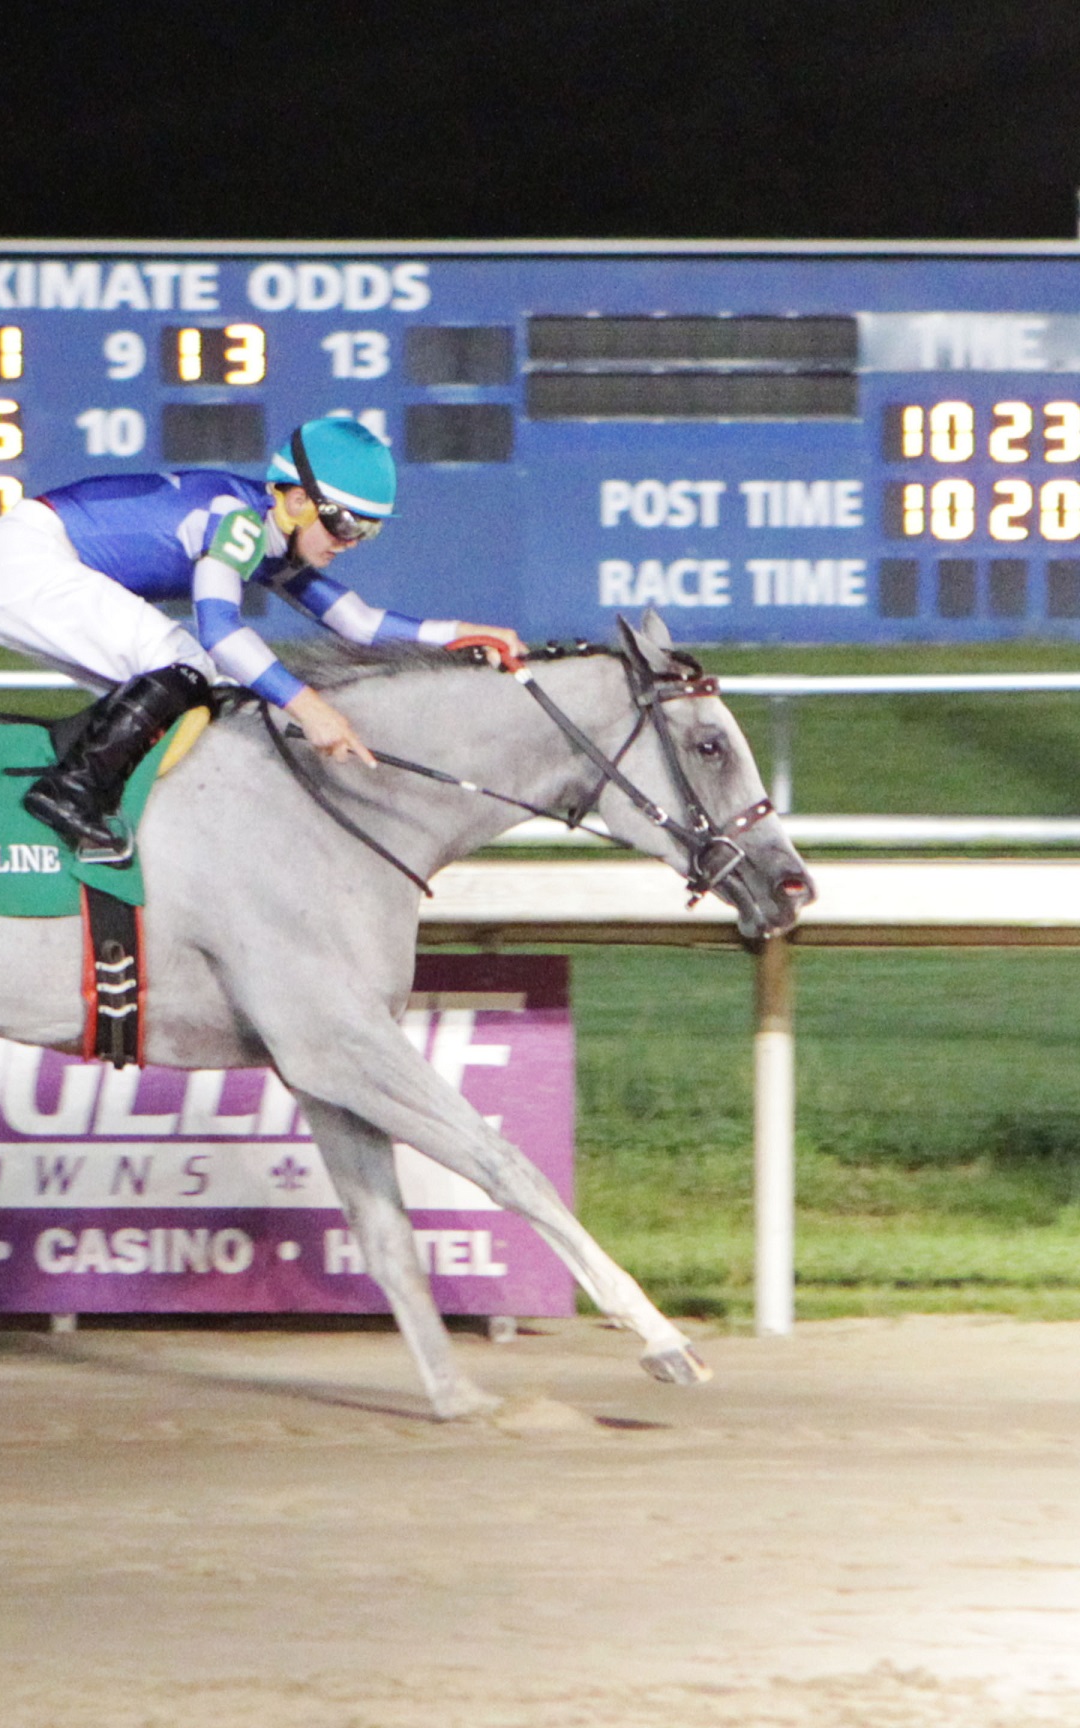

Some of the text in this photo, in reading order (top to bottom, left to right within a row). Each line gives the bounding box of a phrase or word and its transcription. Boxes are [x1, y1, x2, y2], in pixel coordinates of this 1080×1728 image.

[247, 263, 431, 312] ODDS
[0, 326, 22, 380] 1
[104, 330, 146, 380] 9
[321, 330, 390, 380] 13
[76, 408, 146, 457] 10
[600, 480, 726, 528] POST
[739, 481, 864, 528] TIME
[223, 516, 262, 564] 5
[598, 559, 868, 607] RACE TIME
[34, 1227, 254, 1275] CASINO
[324, 1228, 508, 1277] HTEL
